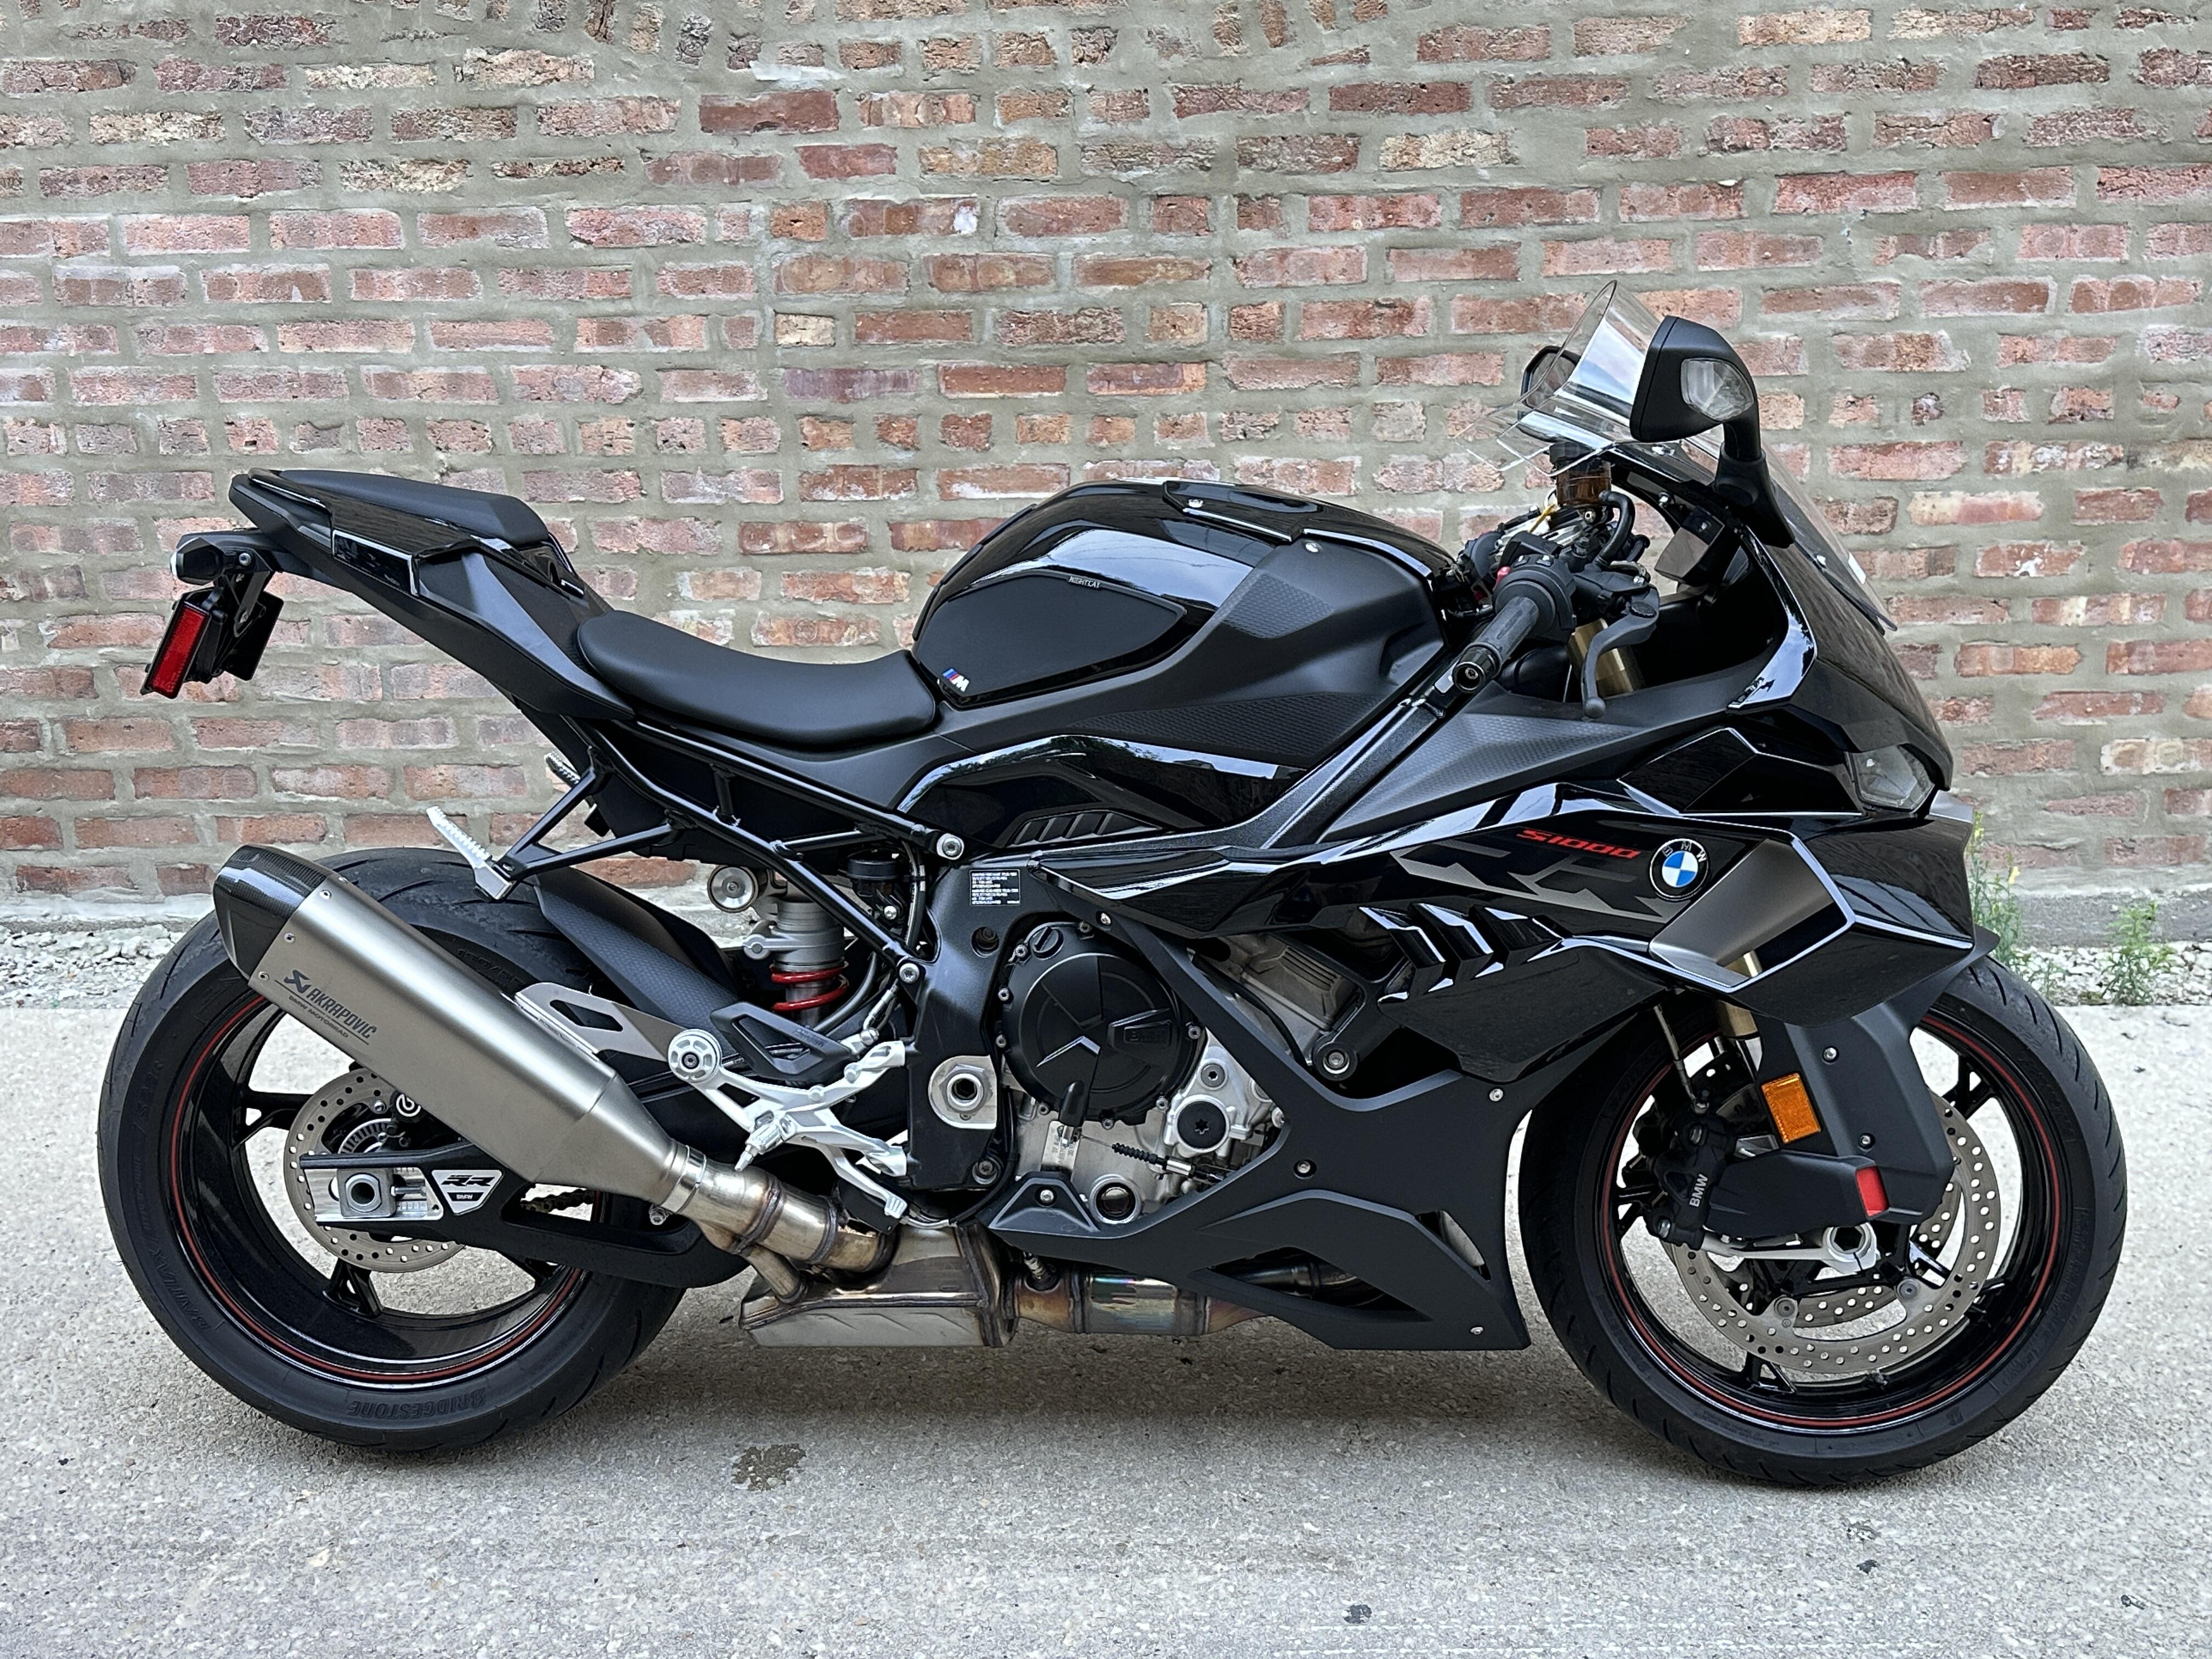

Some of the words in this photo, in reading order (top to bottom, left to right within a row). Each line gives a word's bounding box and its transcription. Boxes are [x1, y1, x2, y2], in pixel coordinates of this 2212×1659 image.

[1516, 828, 1642, 859] S1000
[1662, 840, 1707, 862] BMW
[289, 995, 308, 1010] BMW
[307, 1008, 349, 1038] MOTORRAD
[1689, 1173, 1708, 1207] BMW
[346, 1388, 486, 1420] BRIDGESTONE
